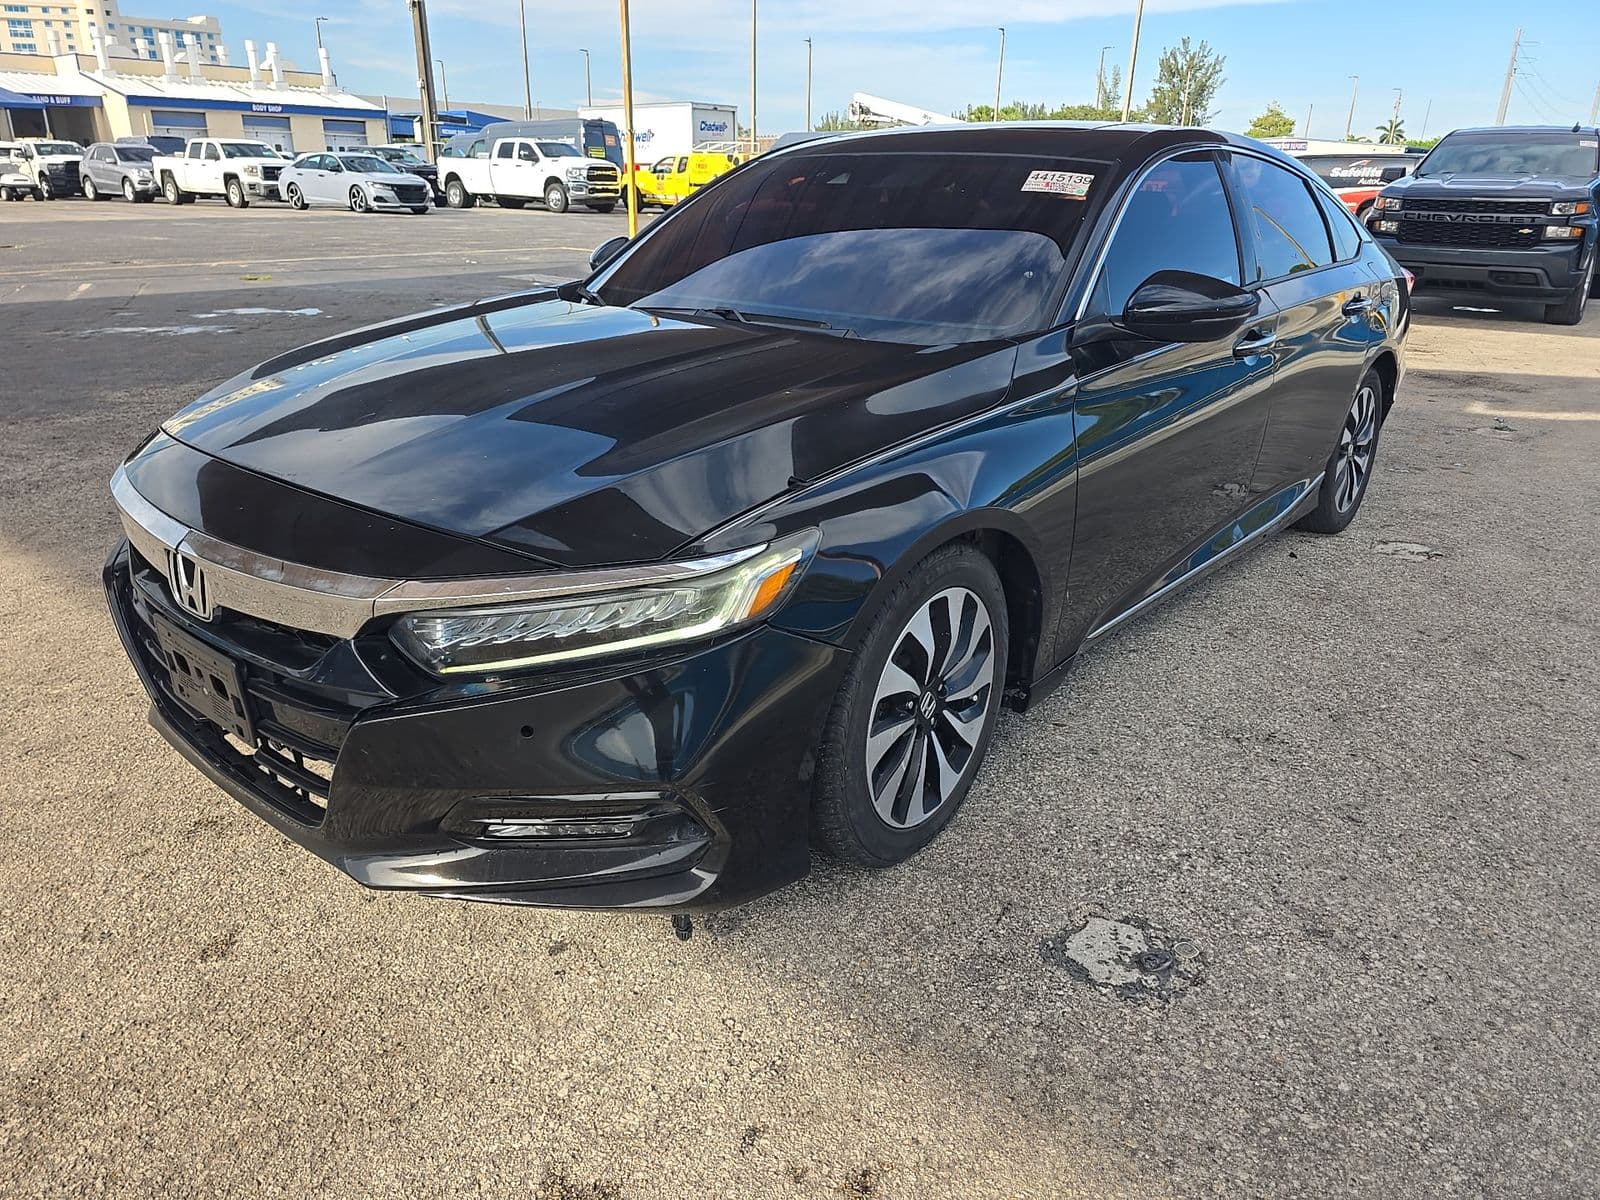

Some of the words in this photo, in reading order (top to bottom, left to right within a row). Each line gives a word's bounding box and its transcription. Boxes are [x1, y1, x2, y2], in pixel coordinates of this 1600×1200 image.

[252, 103, 267, 112] BODY
[1031, 173, 1093, 184] 4415139
[1403, 212, 1542, 224] CHEVROLET
